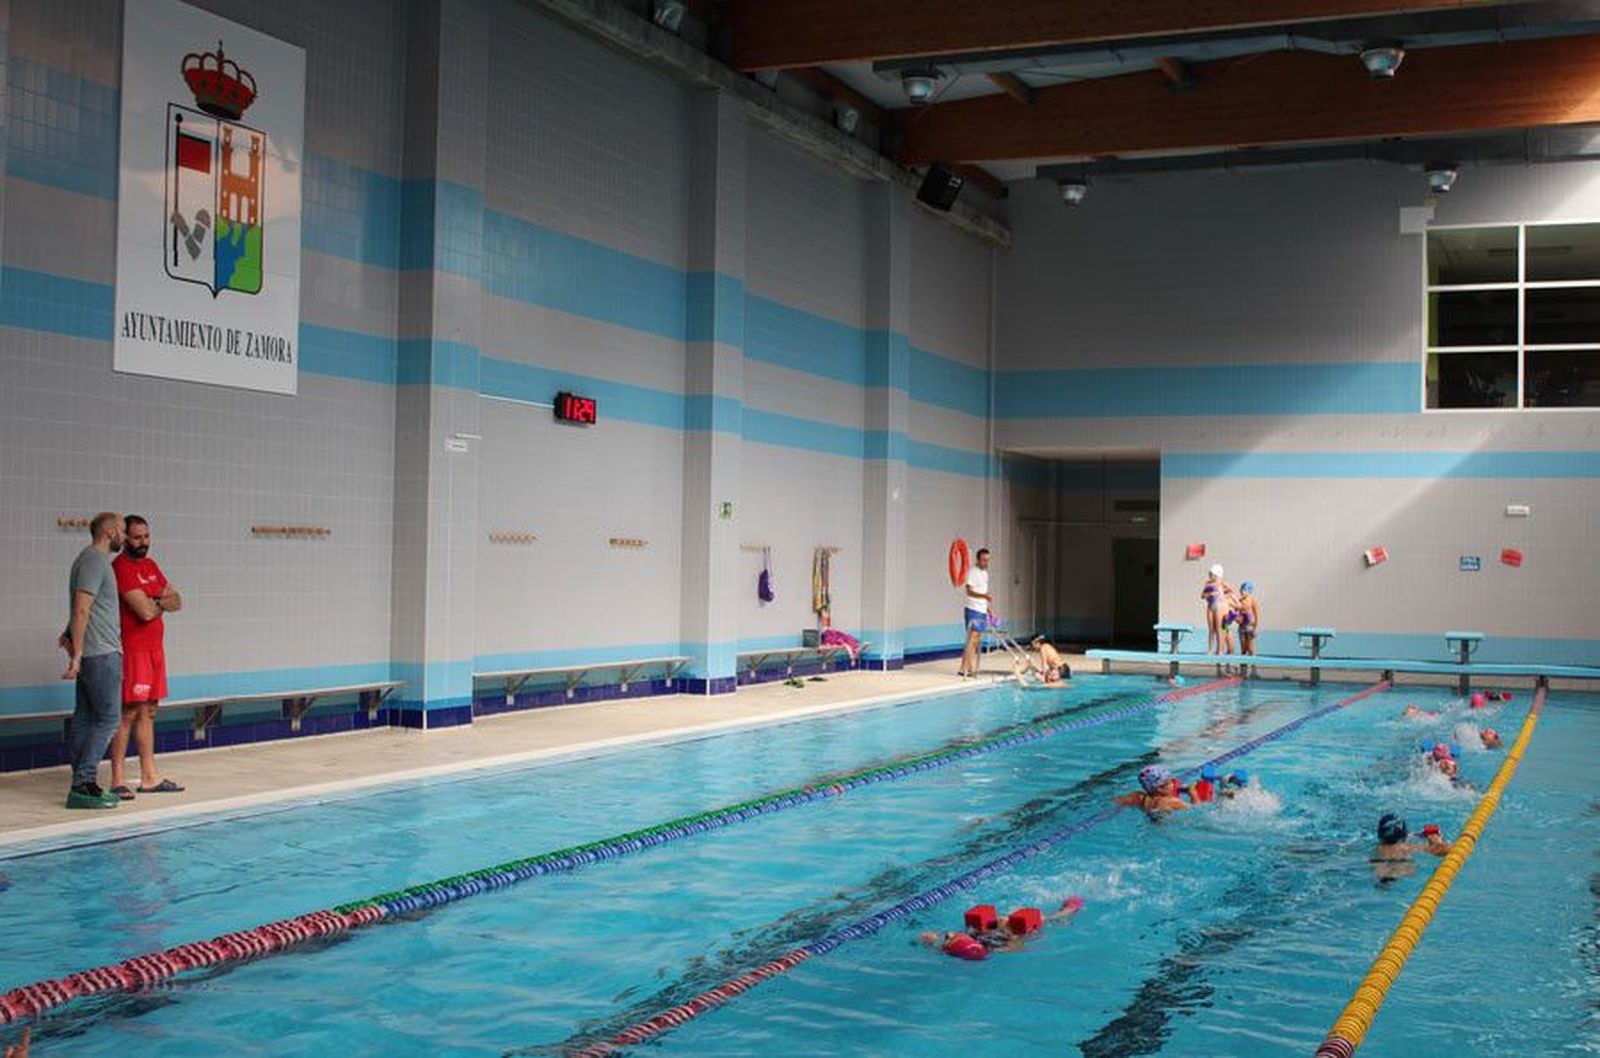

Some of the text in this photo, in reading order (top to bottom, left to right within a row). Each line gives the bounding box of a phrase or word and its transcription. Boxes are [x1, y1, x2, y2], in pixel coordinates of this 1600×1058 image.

[122, 312, 292, 364] AYUNTAMIENTO DE ZAMORA
